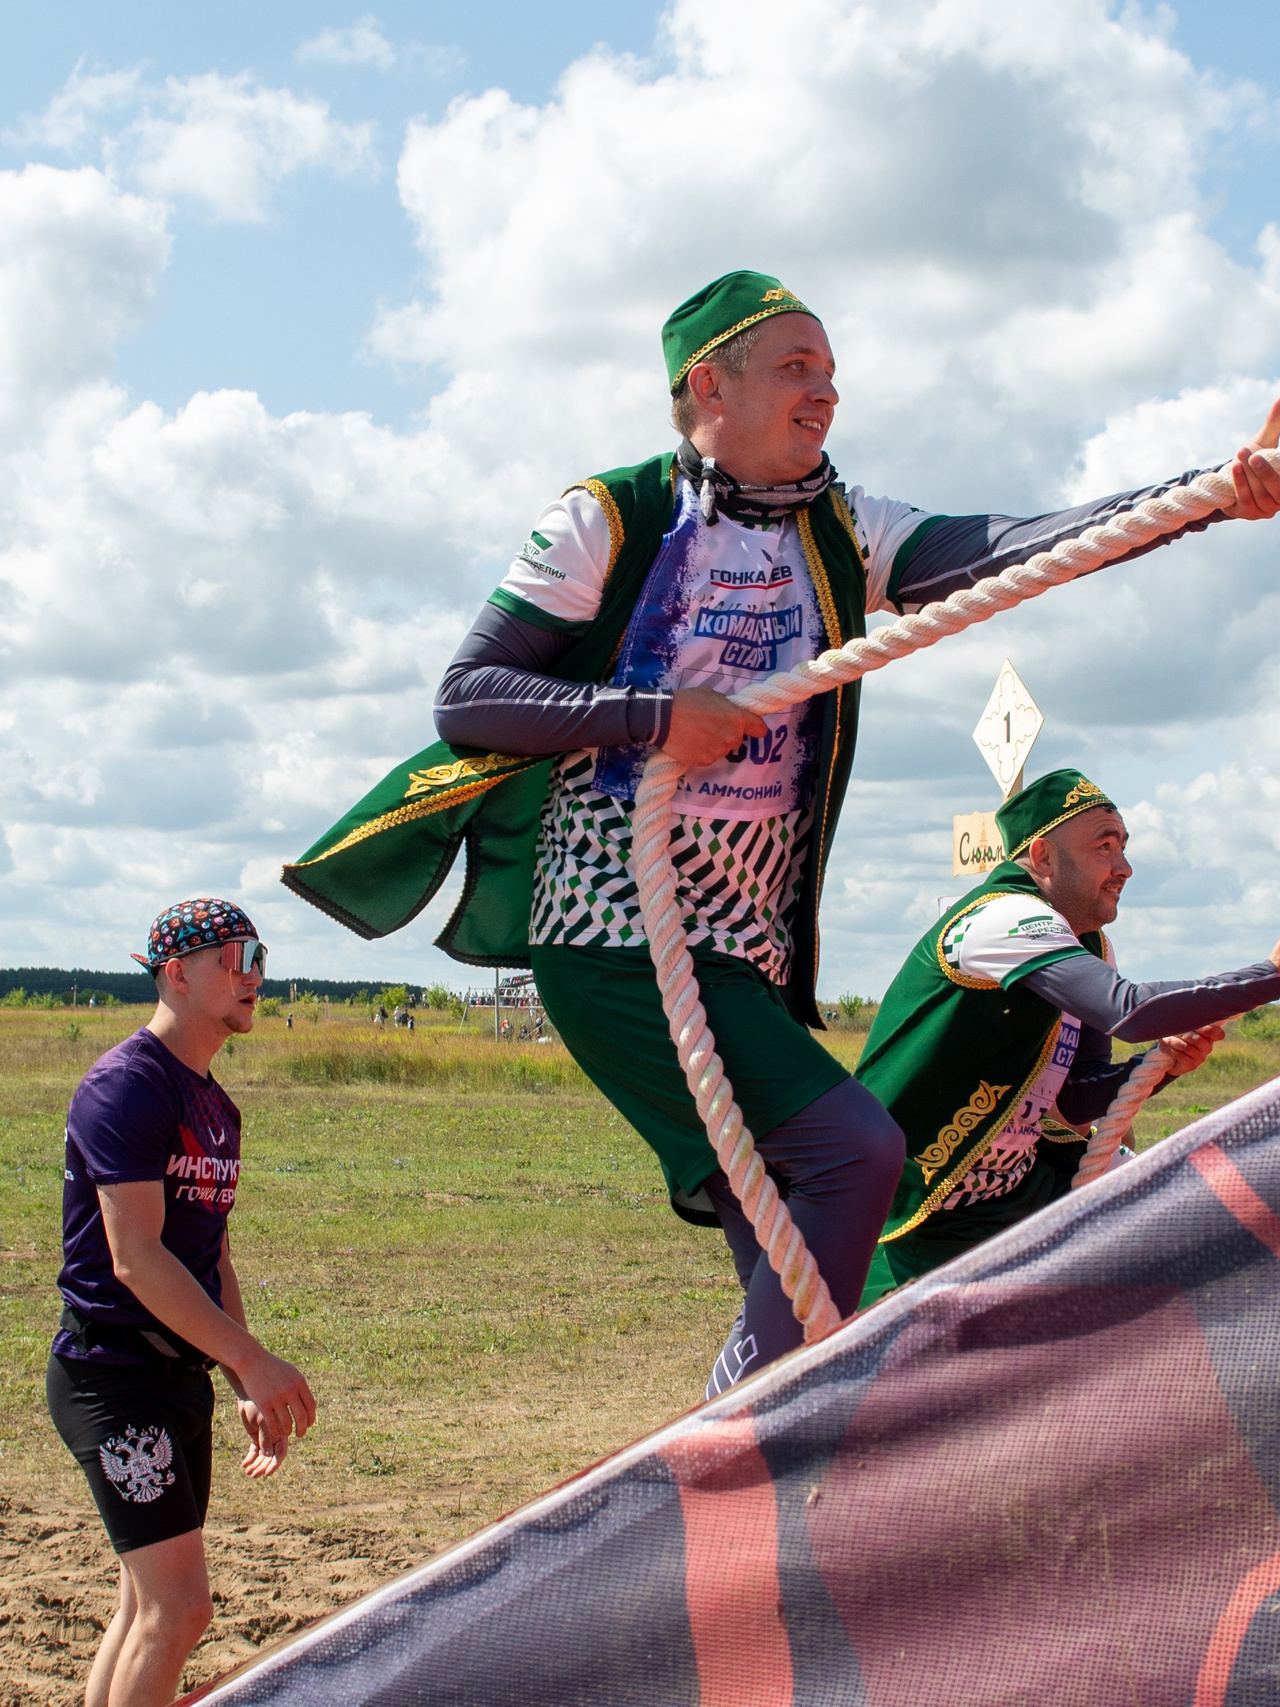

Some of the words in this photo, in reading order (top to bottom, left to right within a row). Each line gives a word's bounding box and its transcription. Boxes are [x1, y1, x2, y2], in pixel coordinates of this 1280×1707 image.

[710, 569, 766, 584] ГОНКА
[723, 641, 773, 669] СТАРТ
[1003, 711, 1011, 743] 1
[698, 781, 783, 800] АММОНИЙ
